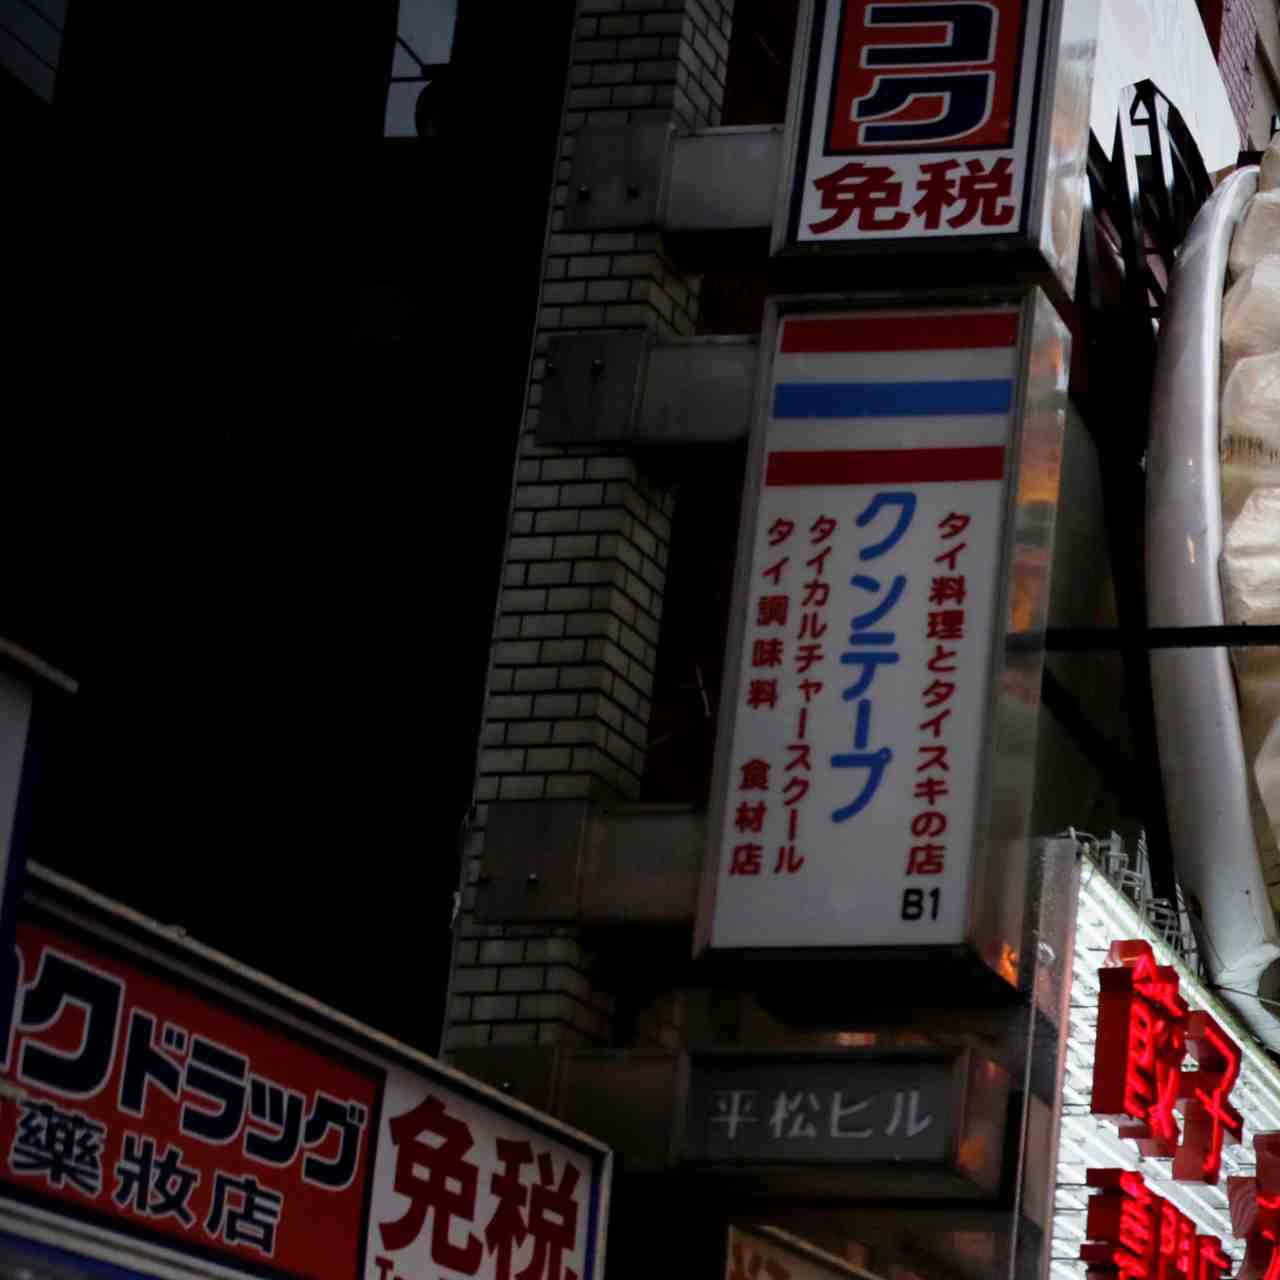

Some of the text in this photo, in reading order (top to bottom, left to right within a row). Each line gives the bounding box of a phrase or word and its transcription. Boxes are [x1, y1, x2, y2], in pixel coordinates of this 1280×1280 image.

[808, 157, 1017, 235] 免税
[729, 517, 795, 877] タイ調味料 食材店
[774, 514, 838, 875] タイカルチャースクール
[830, 491, 917, 824] クンテープ
[905, 511, 974, 877] タイ料理とタイスキの店
[3, 944, 367, 1190] クドラッグ
[901, 887, 942, 921] B1
